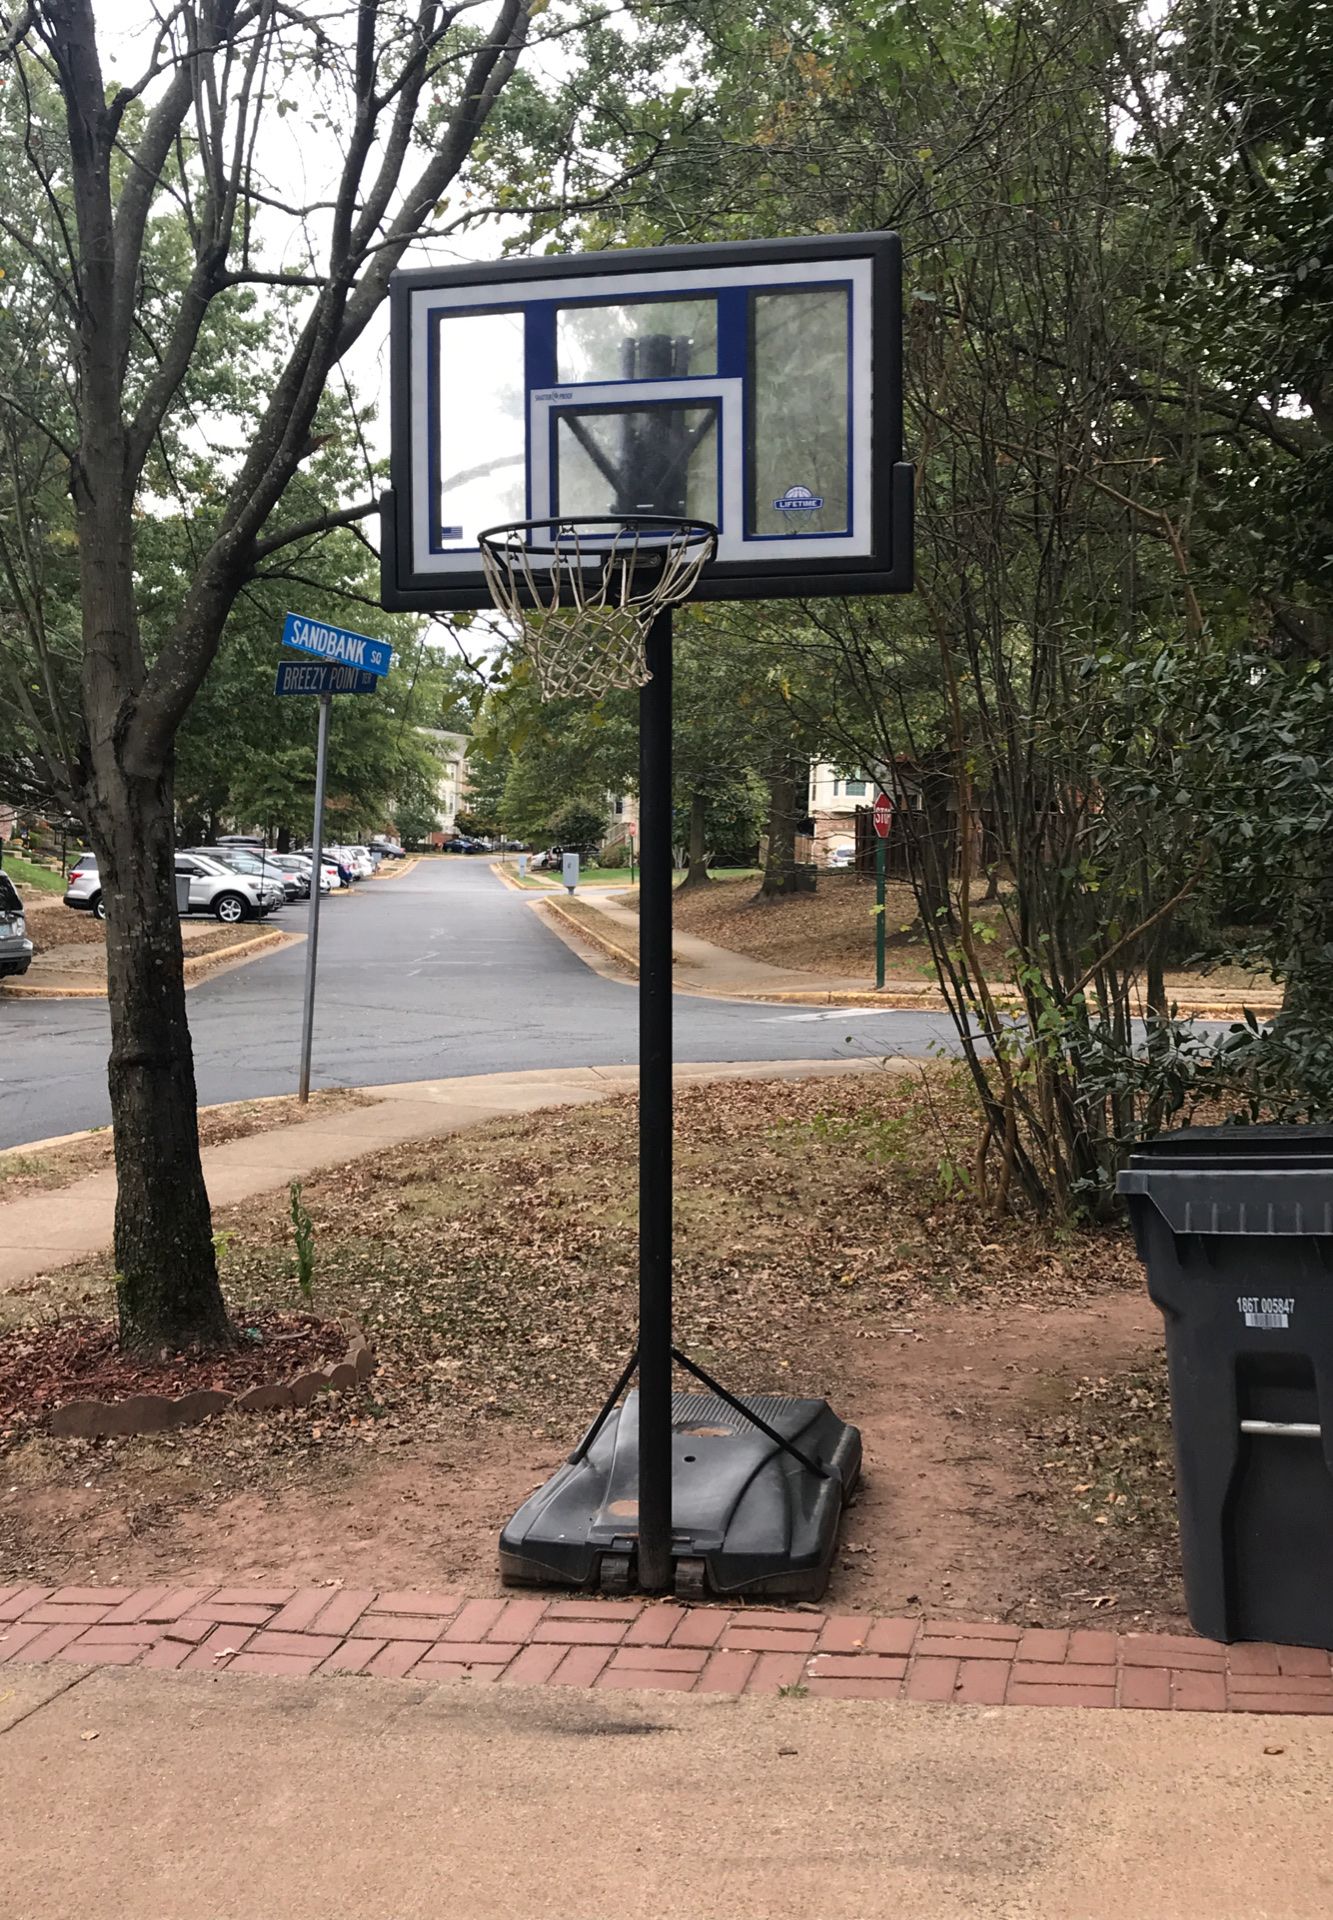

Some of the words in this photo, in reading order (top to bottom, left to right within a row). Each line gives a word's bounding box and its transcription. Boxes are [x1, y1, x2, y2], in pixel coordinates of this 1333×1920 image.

[779, 500, 817, 508] LIFETIME
[291, 620, 367, 665] SANDBANK
[370, 650, 382, 665] SQ
[283, 666, 327, 690] BREEZY
[328, 667, 360, 690] POINT
[875, 807, 891, 824] STOP
[1236, 1296, 1259, 1313] 186T
[1260, 1297, 1295, 1314] 005847
